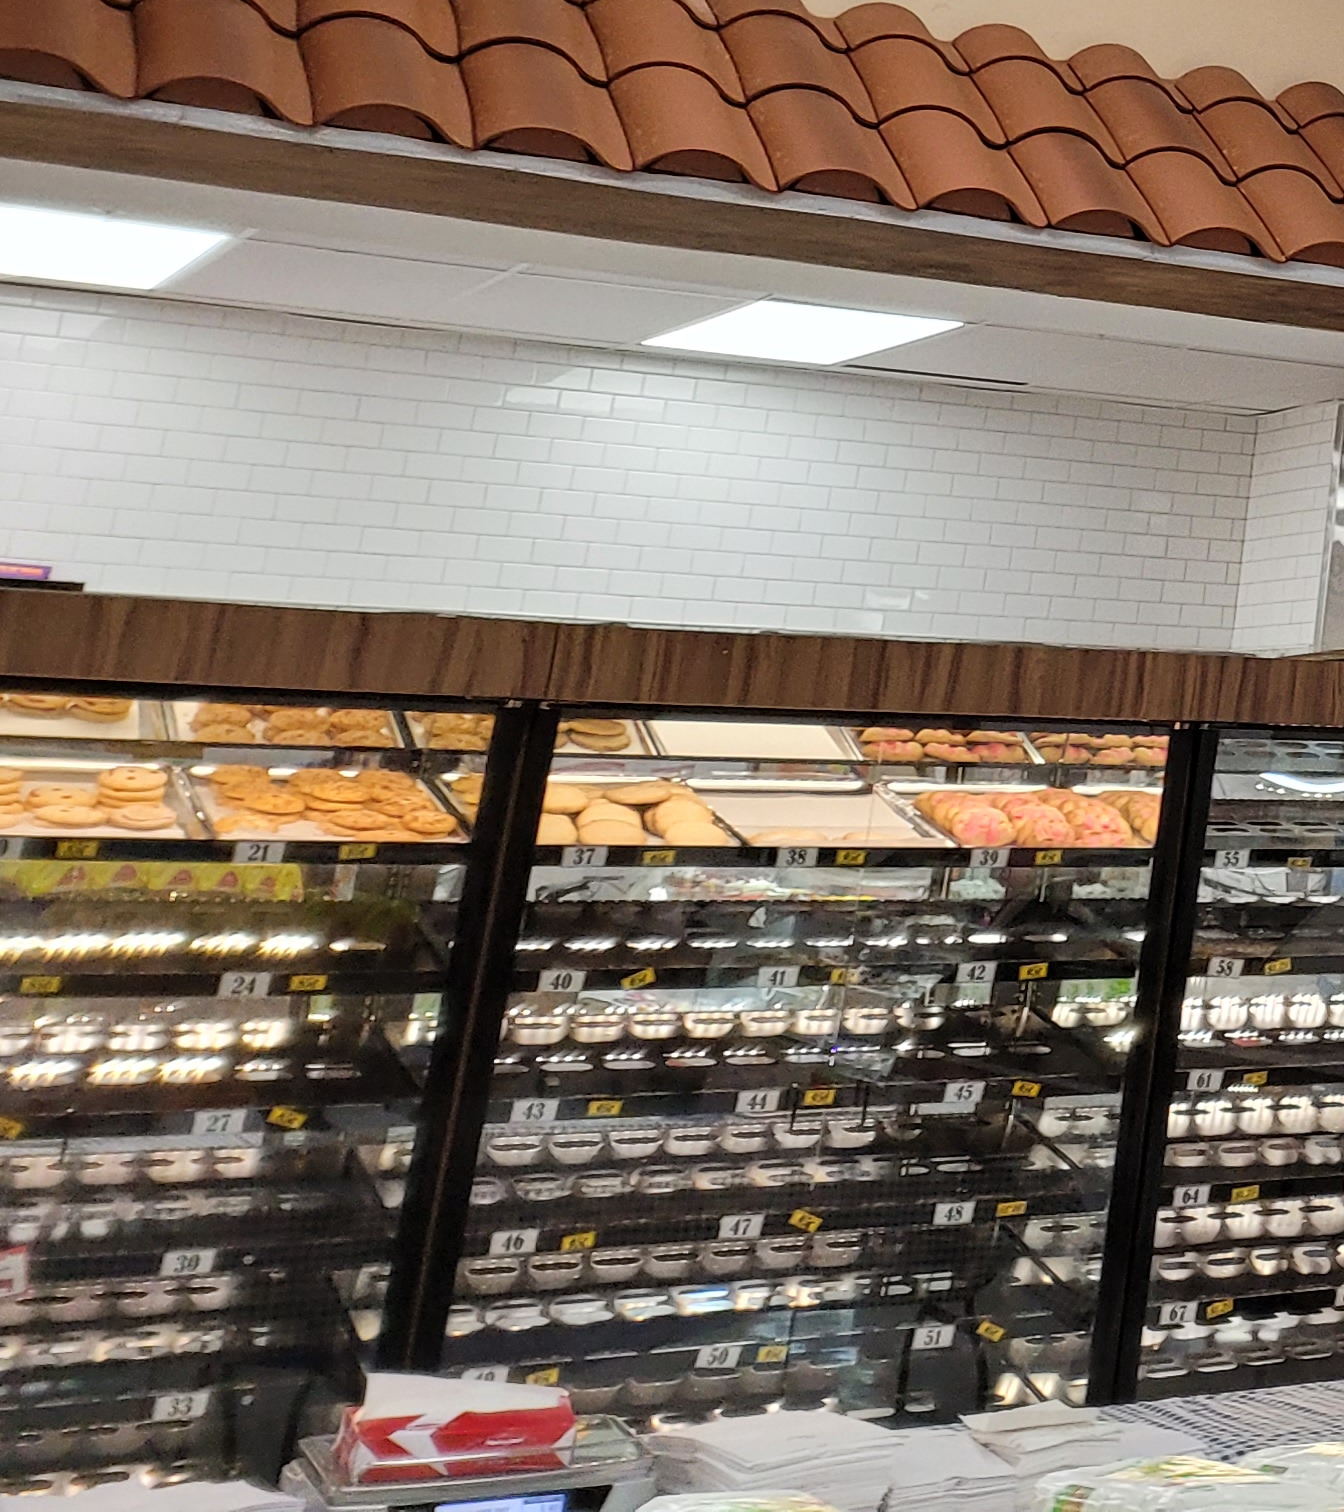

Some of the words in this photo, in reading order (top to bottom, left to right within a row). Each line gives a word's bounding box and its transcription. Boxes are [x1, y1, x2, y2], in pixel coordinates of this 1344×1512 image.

[248, 844, 269, 862] 21
[573, 848, 595, 865] 37
[980, 850, 999, 866] 39
[1222, 851, 1240, 867] 55
[549, 972, 573, 990] 40
[768, 970, 786, 986] 41
[966, 964, 986, 981] 42
[1196, 1072, 1213, 1088] 61
[953, 1084, 974, 1101] 45
[746, 1093, 768, 1110] 44
[522, 1102, 546, 1120] 43
[206, 1114, 232, 1132] 27
[1181, 1188, 1200, 1204] 64
[728, 1218, 752, 1236] 47
[502, 1234, 525, 1252] 46
[1168, 1304, 1188, 1322] 67
[923, 1329, 942, 1346] 51
[706, 1348, 729, 1365] 50
